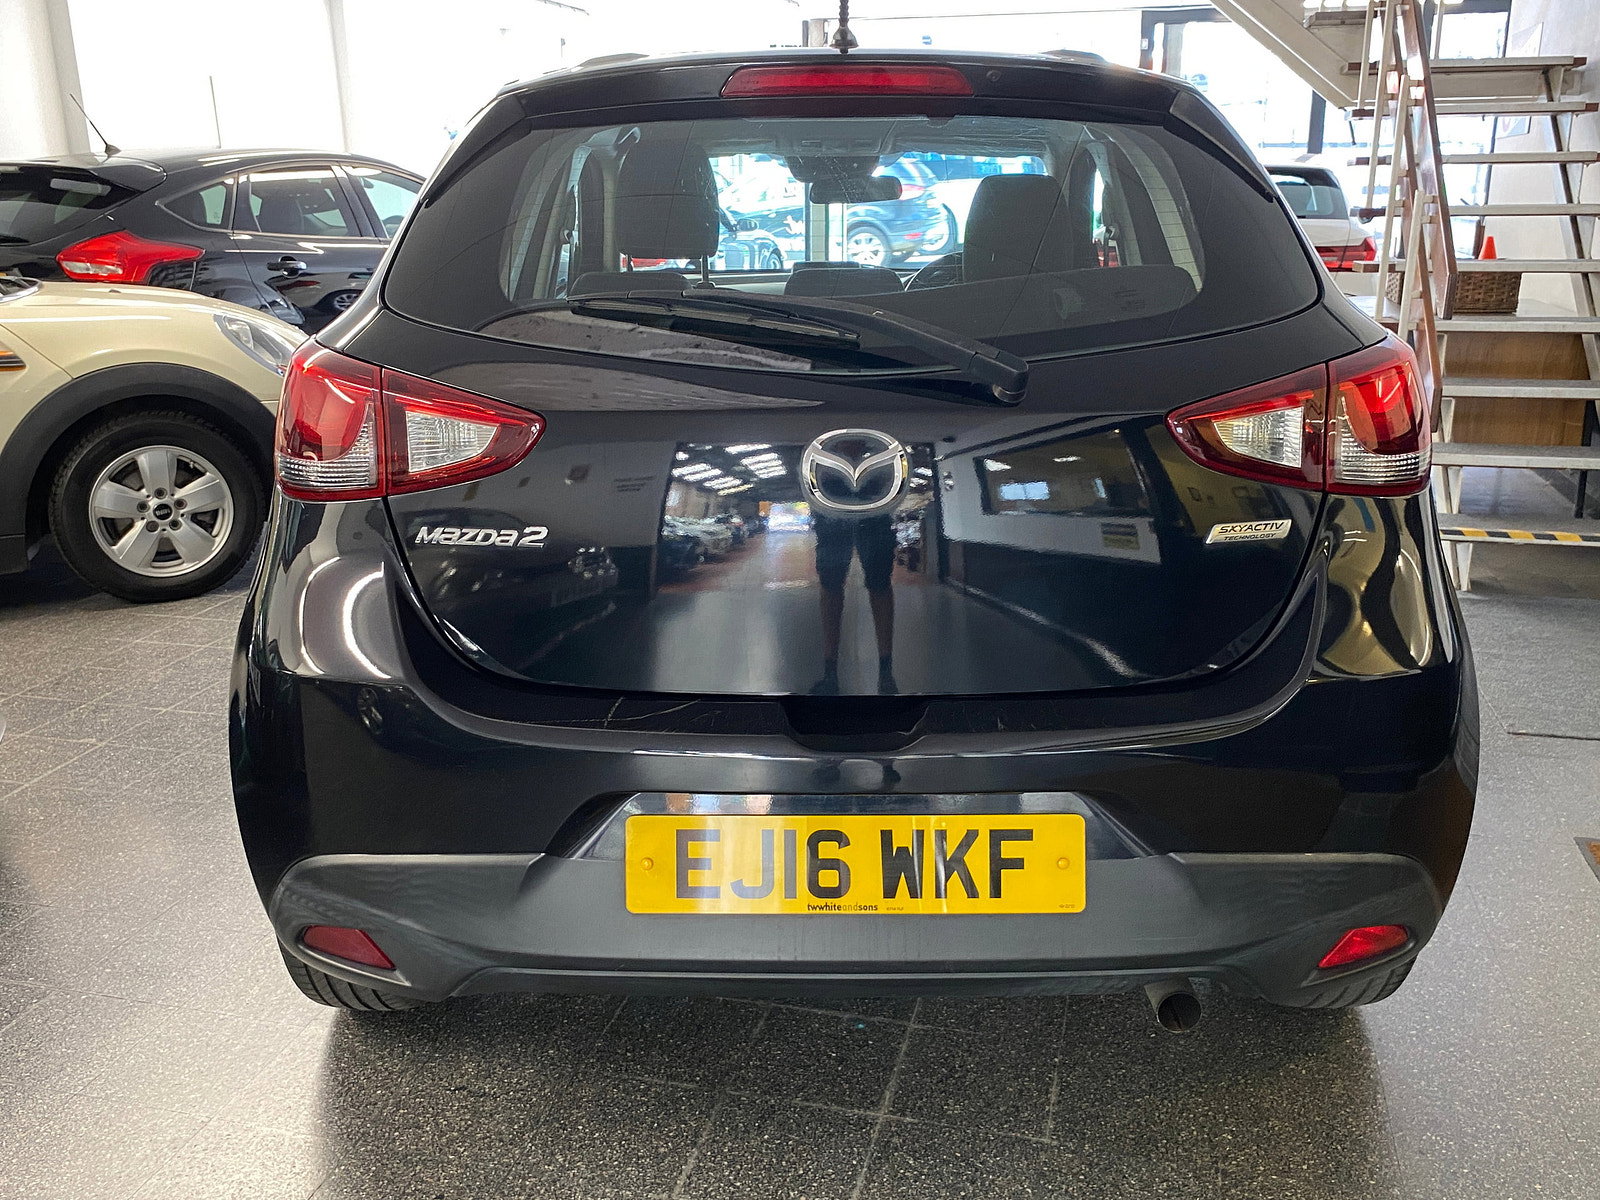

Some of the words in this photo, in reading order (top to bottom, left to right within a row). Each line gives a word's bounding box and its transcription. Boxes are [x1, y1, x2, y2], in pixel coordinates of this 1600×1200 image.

[1218, 521, 1285, 534] SKYACTIV
[1223, 532, 1277, 541] TECHNOLOGY
[675, 828, 852, 899] EJ16
[880, 828, 1034, 899] WKF
